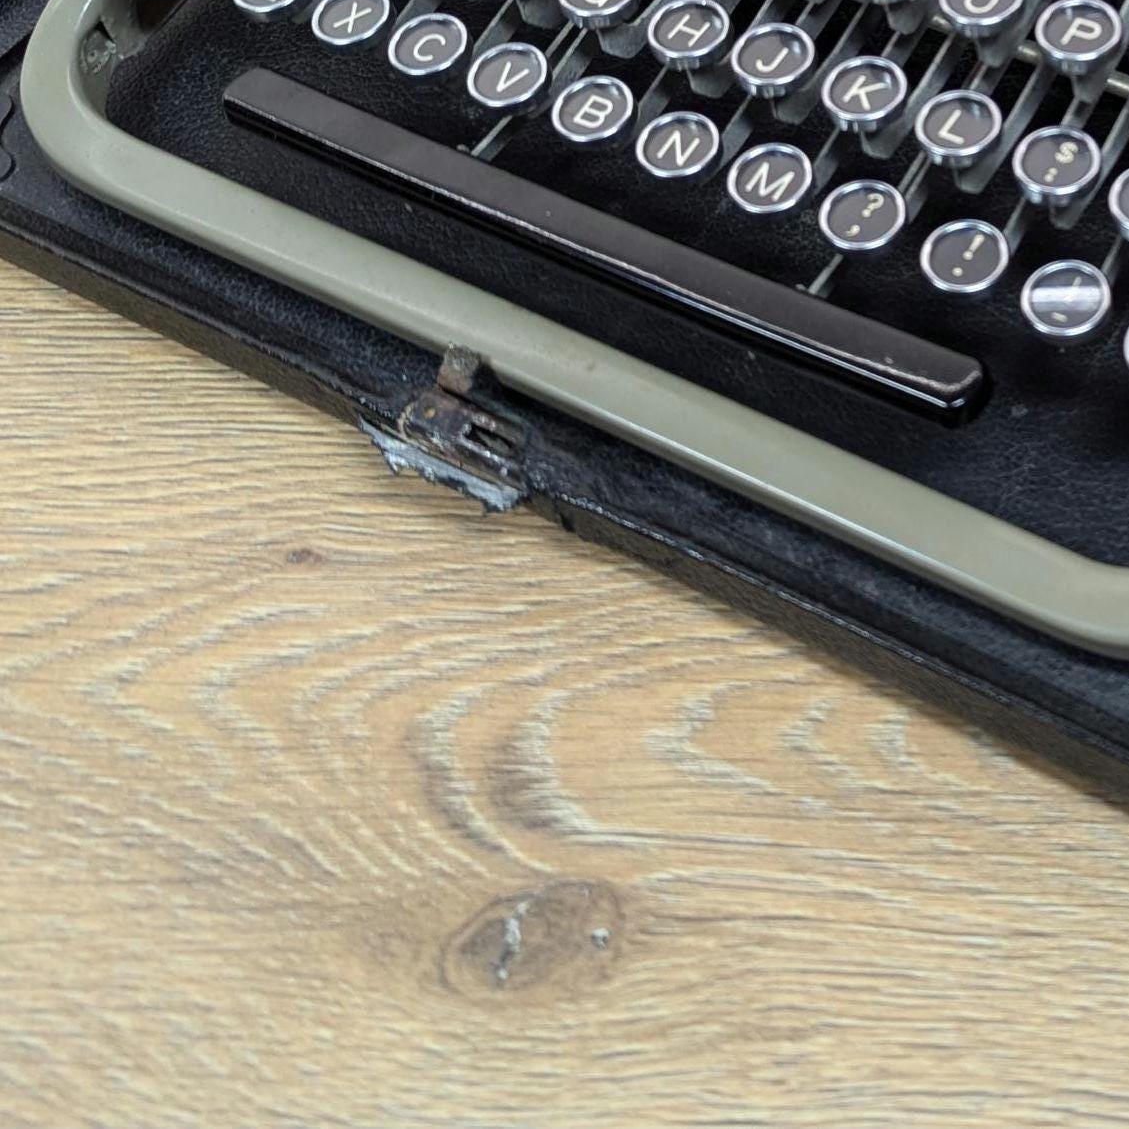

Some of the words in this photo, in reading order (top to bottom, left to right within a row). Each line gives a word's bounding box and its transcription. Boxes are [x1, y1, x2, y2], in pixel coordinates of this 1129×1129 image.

[332, 2, 373, 33] X
[667, 14, 711, 48] H
[1060, 16, 1103, 45] P
[412, 32, 446, 62] C
[755, 47, 790, 72] J
[496, 61, 530, 93] V
[842, 74, 888, 111] K
[573, 95, 614, 129] B
[937, 109, 965, 145] L
[656, 129, 701, 167] N
[745, 161, 796, 202] M
[861, 192, 885, 218] ?
[963, 234, 985, 261] !
